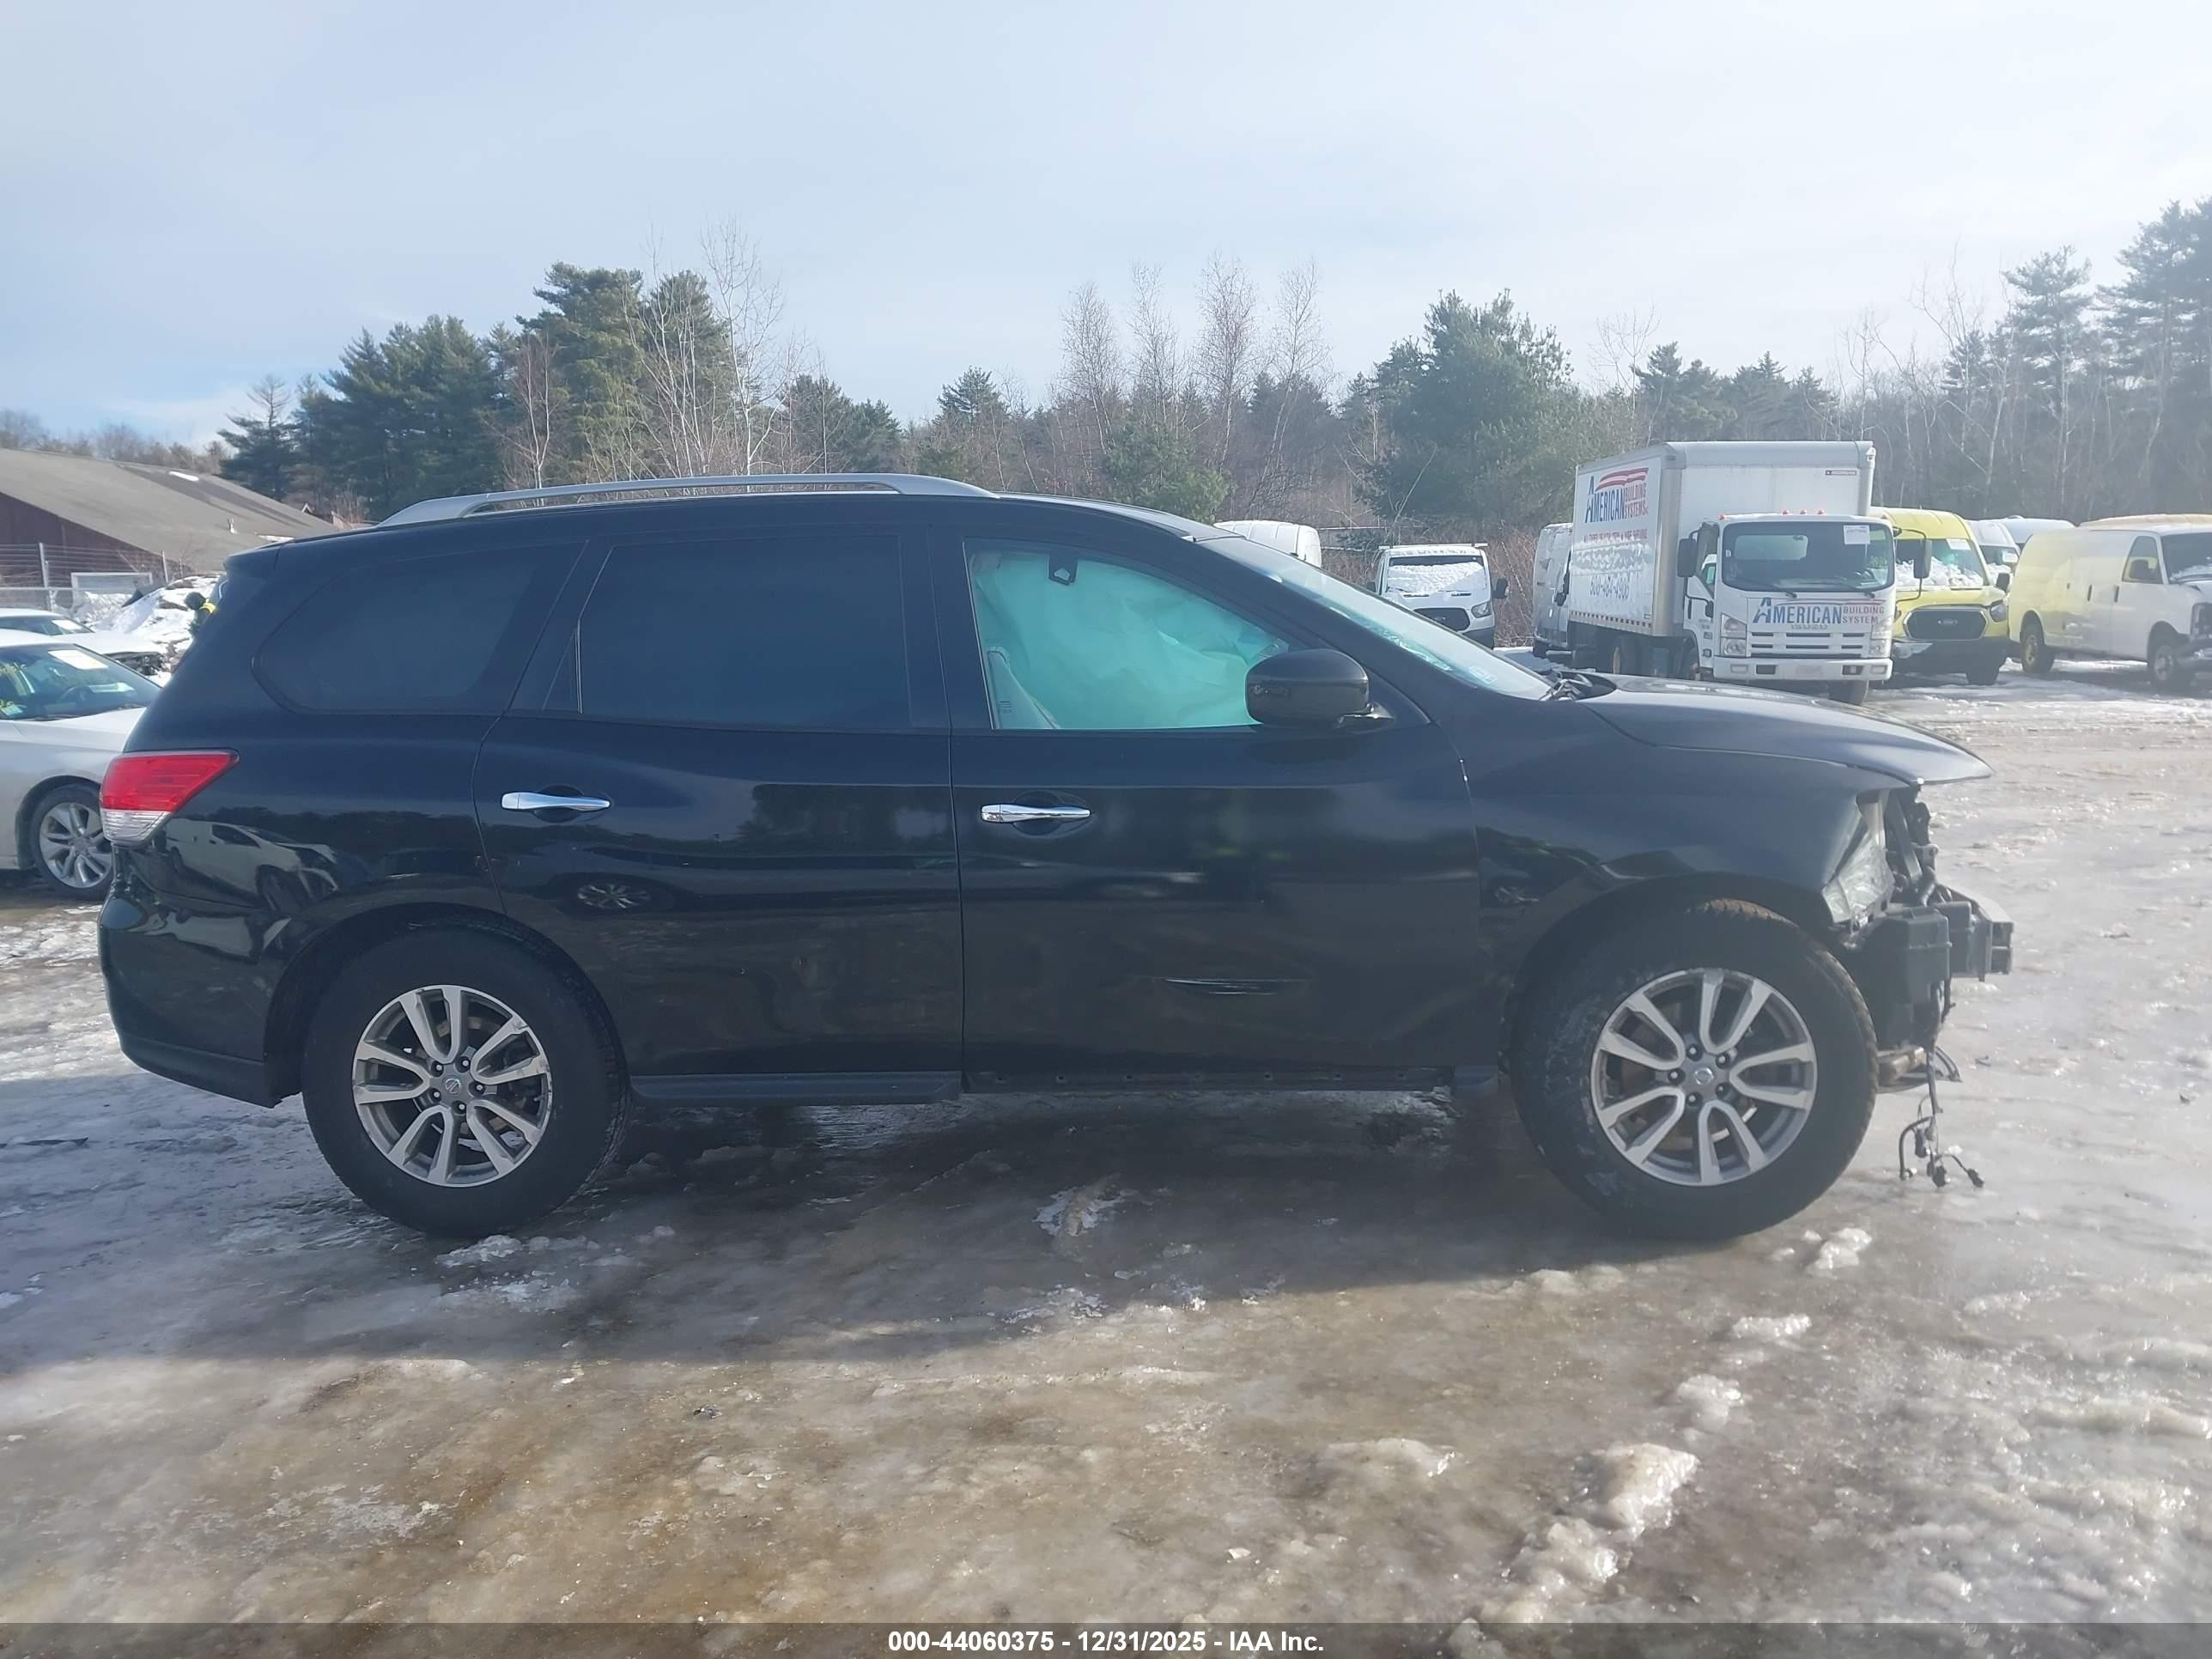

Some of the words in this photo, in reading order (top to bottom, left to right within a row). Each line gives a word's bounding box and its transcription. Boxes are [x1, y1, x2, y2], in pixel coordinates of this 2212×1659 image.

[1584, 475, 1626, 524] AMERICAN
[1753, 597, 1842, 624] AMERICAN
[1843, 605, 1884, 614] BUILDING
